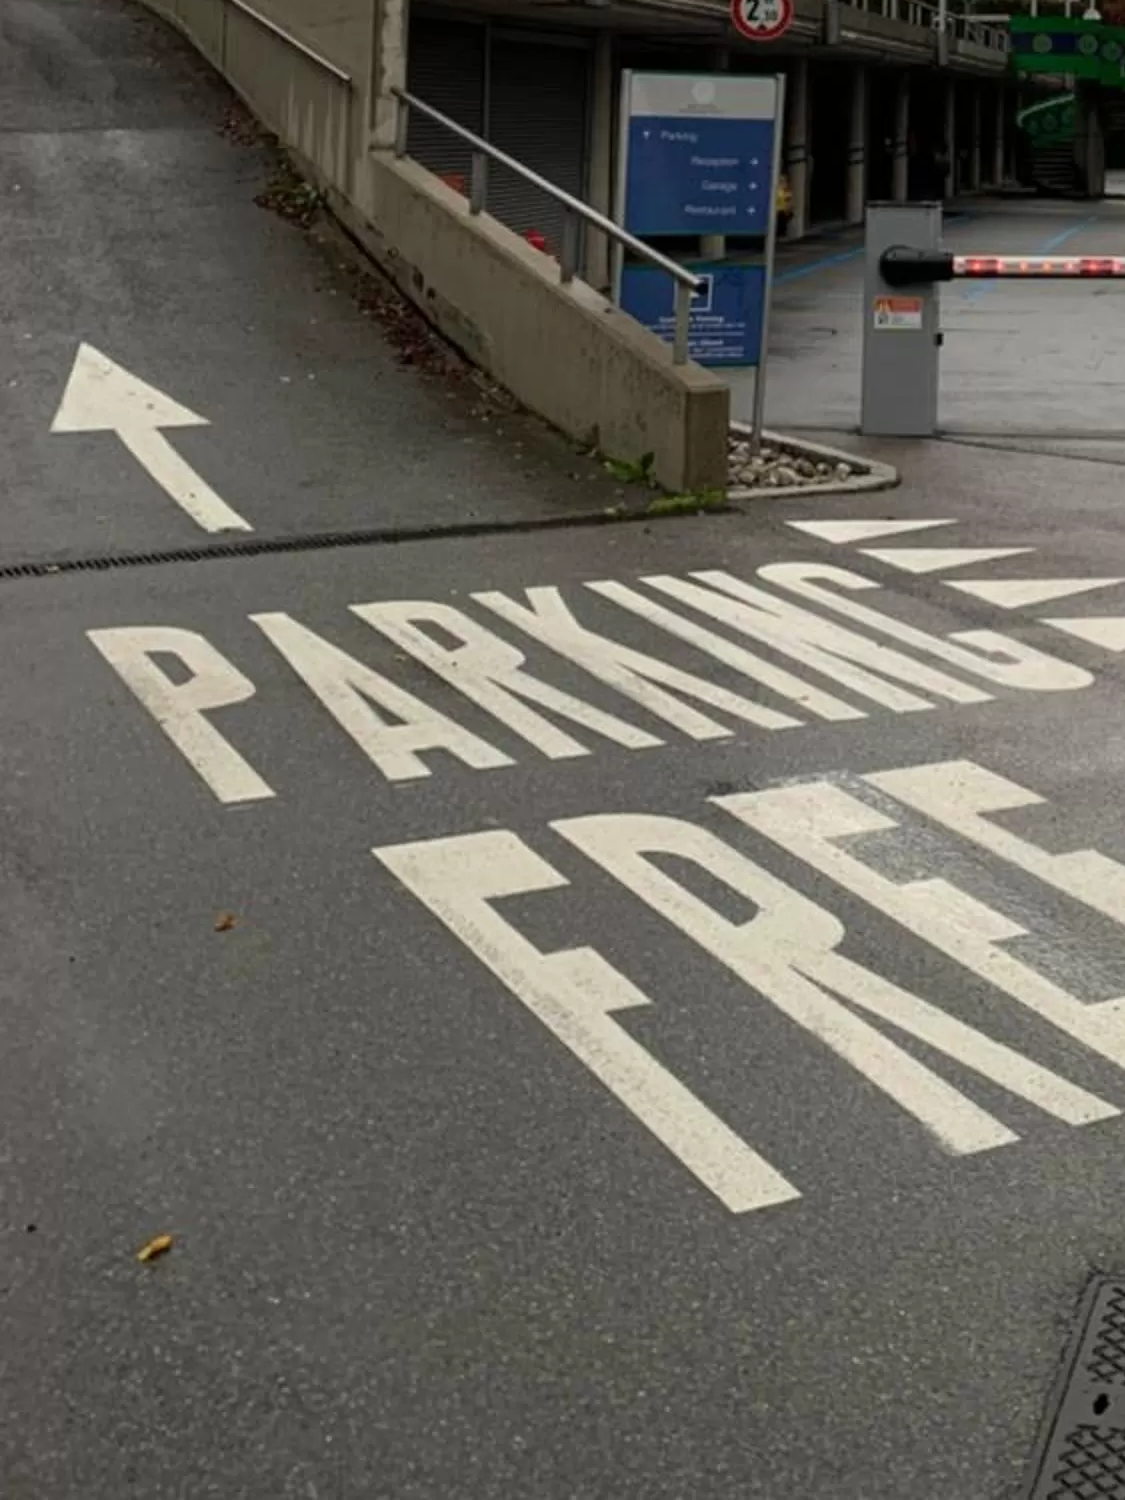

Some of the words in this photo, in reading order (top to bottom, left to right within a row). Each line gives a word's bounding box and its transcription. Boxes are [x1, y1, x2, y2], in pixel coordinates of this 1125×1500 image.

[660, 129, 700, 144] Parking
[700, 180, 739, 194] Garage
[85, 561, 1096, 803] PARKING
